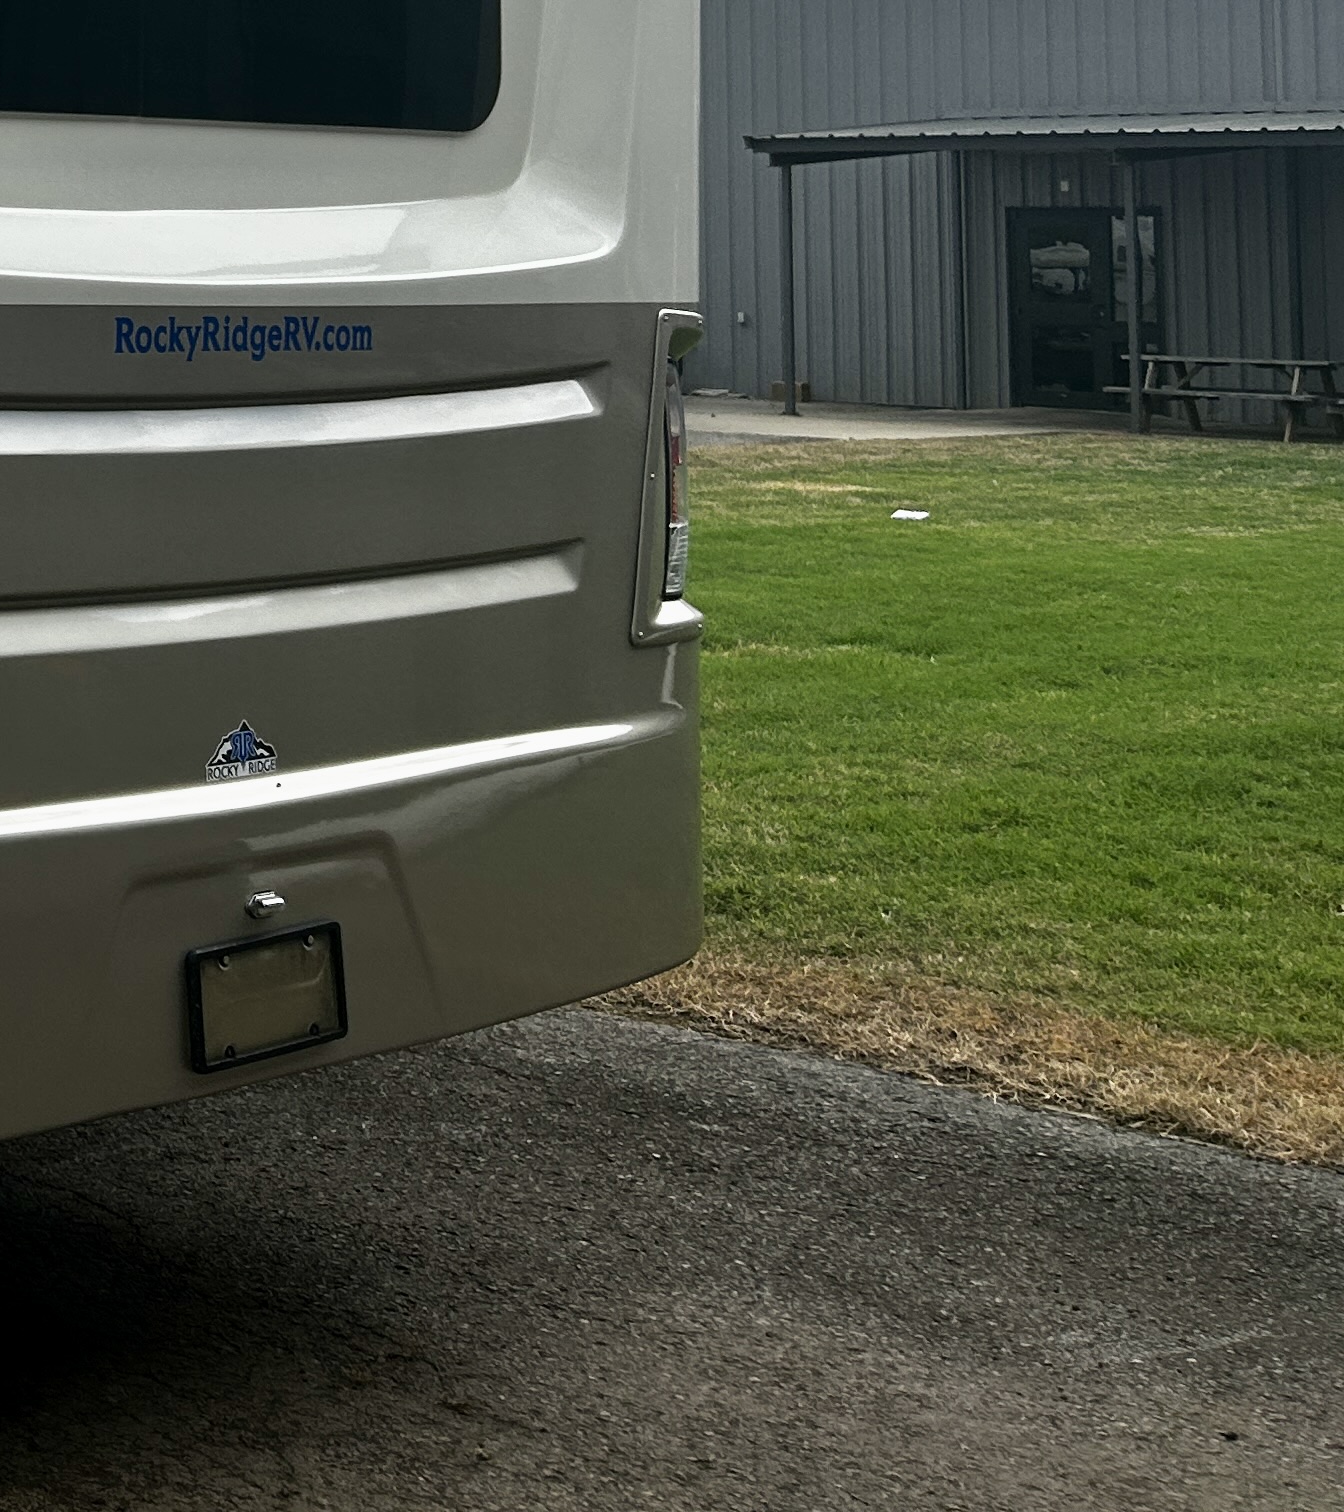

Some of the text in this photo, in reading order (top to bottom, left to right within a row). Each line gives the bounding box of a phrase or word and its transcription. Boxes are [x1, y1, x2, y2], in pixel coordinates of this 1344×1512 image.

[114, 316, 373, 362] RockyRidgeRV.com
[207, 759, 276, 780] ROCKY RIDGE
